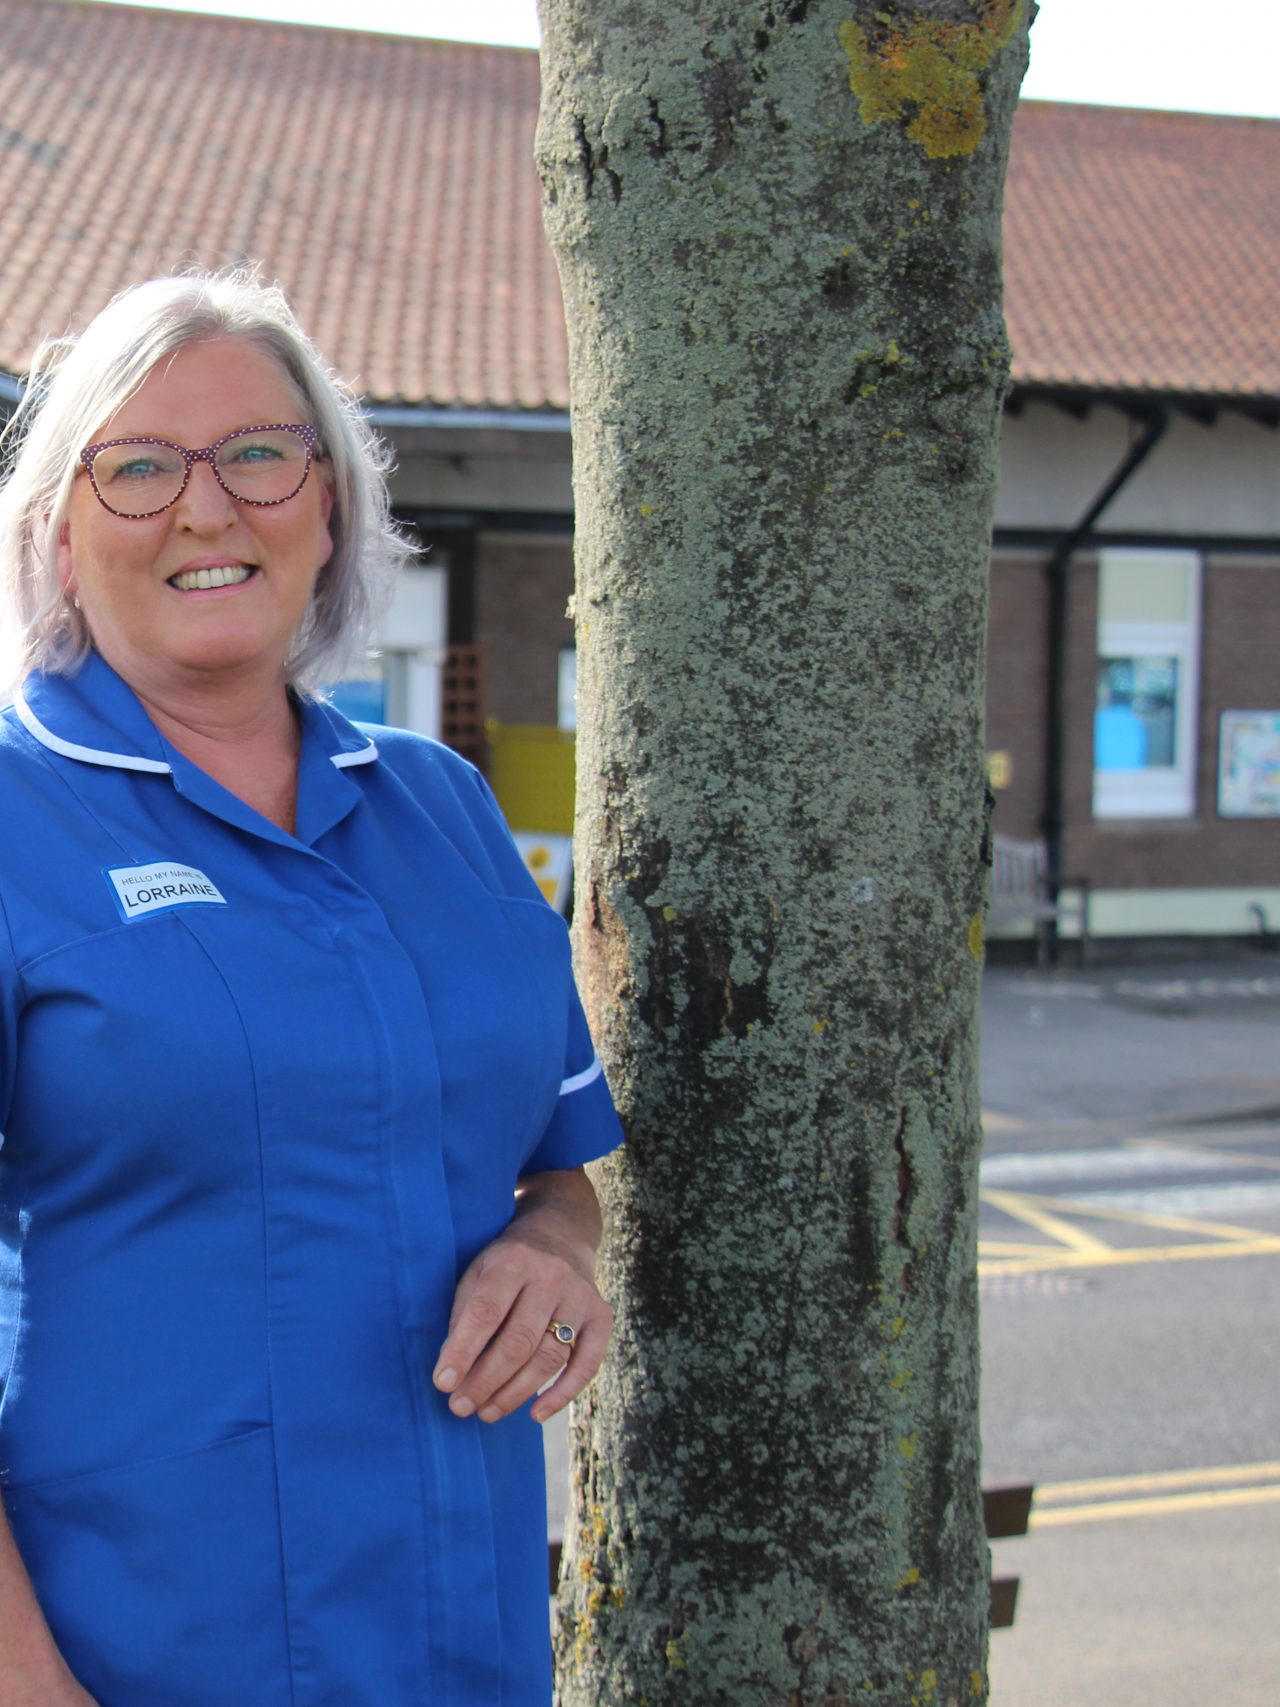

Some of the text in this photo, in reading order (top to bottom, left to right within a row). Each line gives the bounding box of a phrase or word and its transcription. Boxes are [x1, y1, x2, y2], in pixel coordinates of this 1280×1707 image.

[121, 875, 153, 885] HELLO
[154, 871, 167, 880] MY
[170, 870, 193, 878] NAME
[124, 883, 217, 907] LORRAINE
